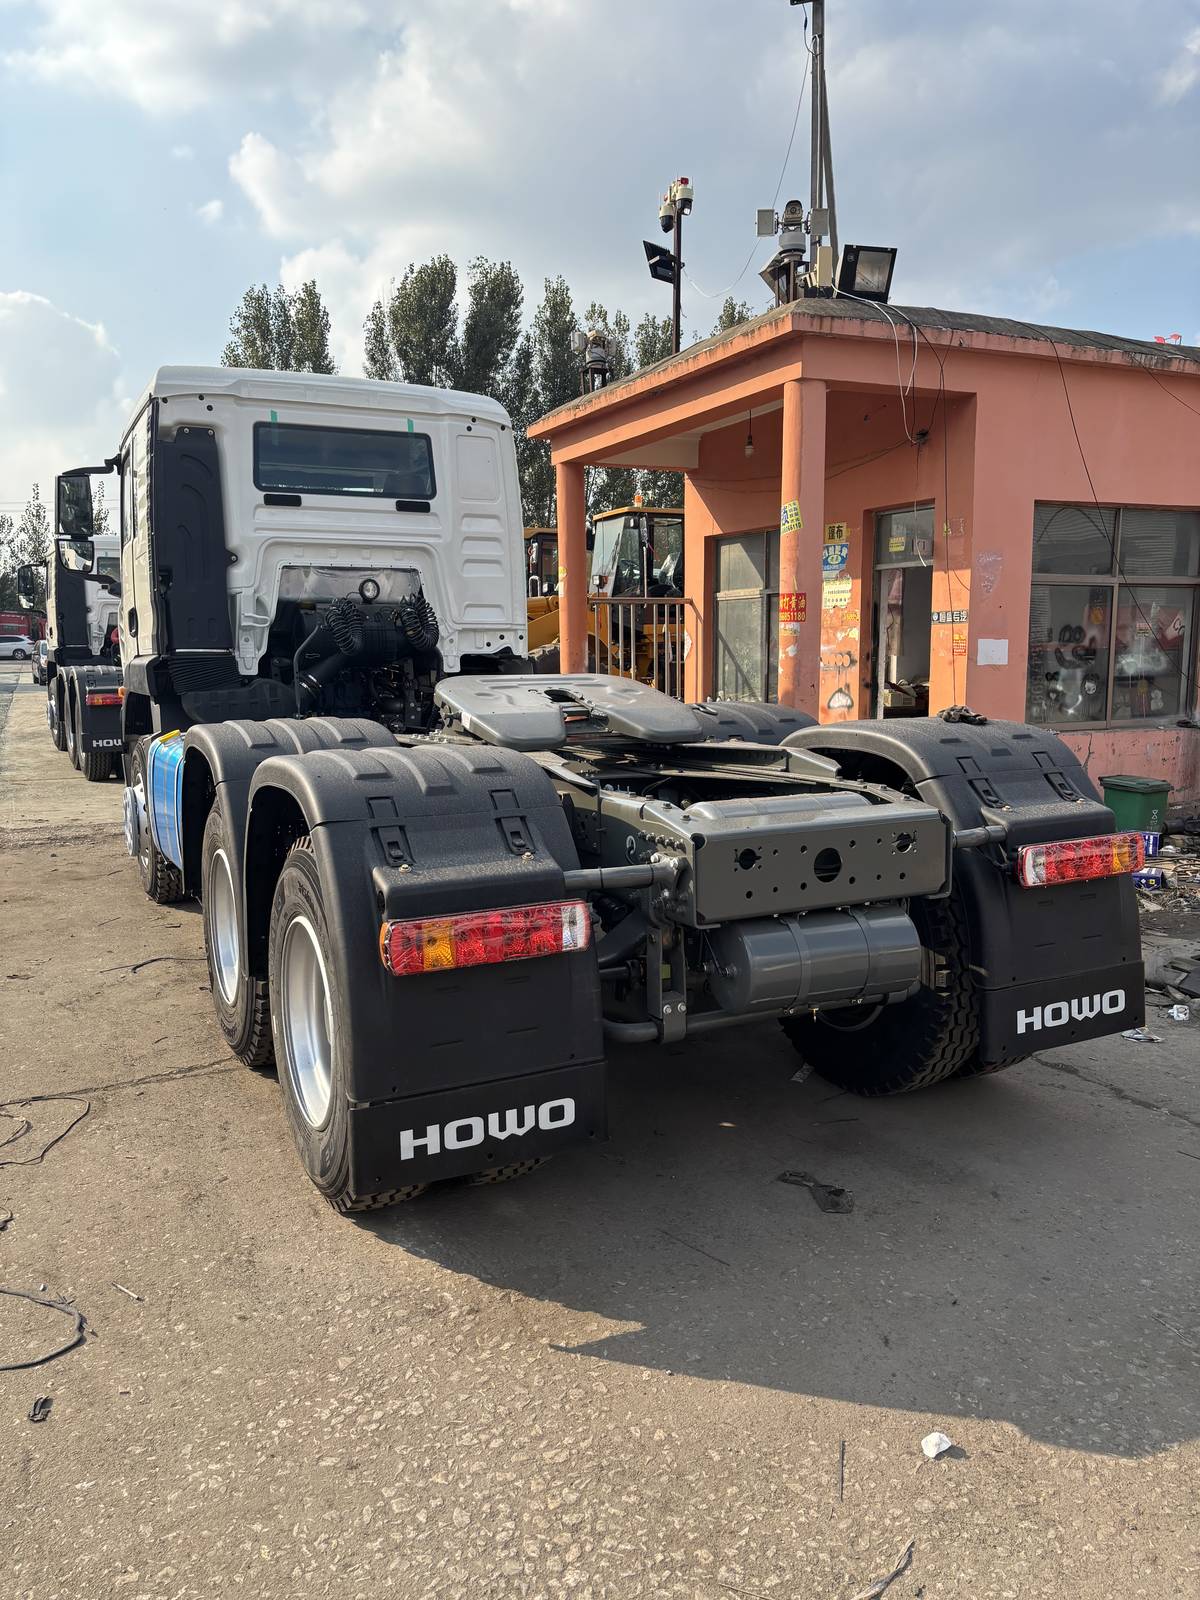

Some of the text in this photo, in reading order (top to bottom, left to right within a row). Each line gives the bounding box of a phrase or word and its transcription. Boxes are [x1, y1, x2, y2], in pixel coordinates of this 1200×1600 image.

[828, 525, 843, 539] 篷布
[92, 738, 122, 748] HOW
[1016, 989, 1126, 1034] HOWO
[399, 1097, 576, 1161] HOWO
